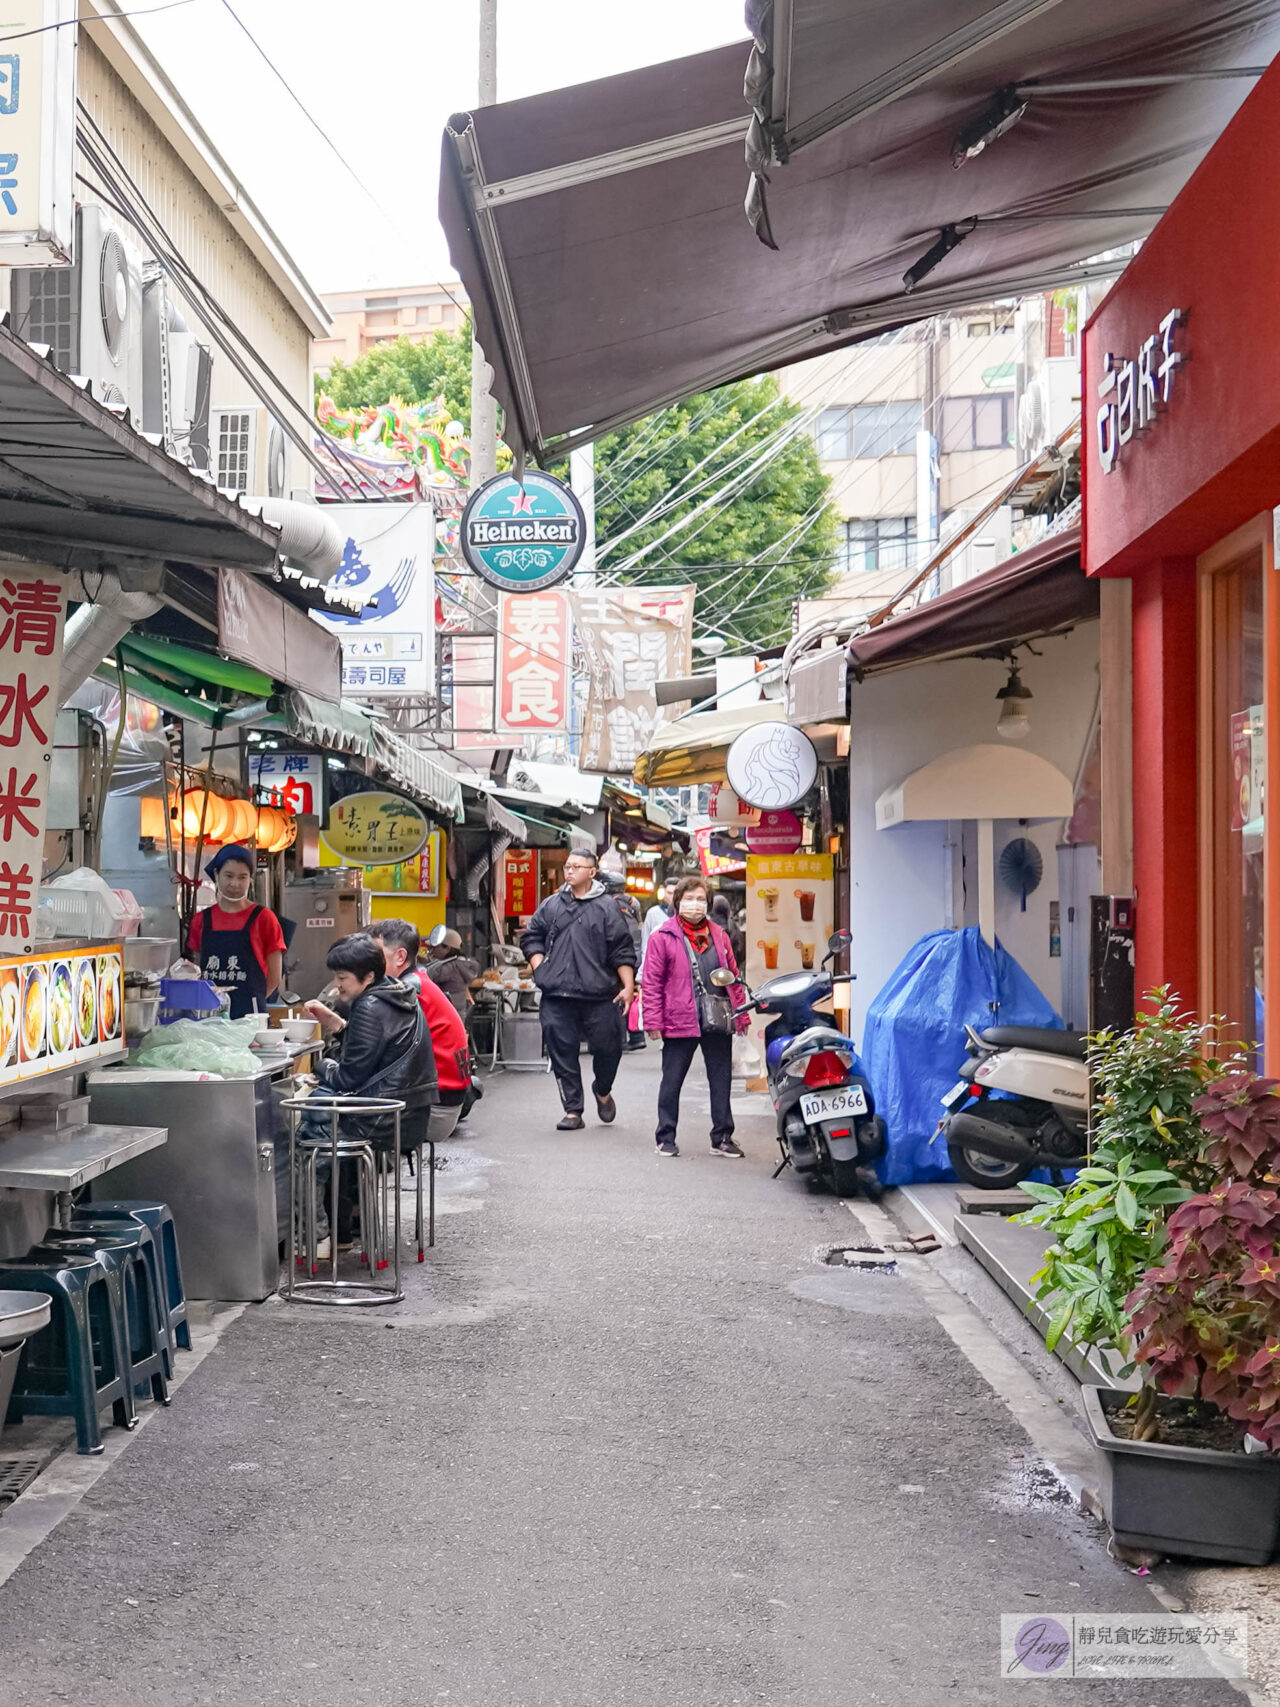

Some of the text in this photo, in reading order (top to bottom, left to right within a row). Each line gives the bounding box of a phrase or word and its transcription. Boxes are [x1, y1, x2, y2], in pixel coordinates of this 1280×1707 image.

[474, 521, 572, 543] Heineken
[506, 596, 562, 723] 素食
[507, 862, 530, 874] 日式
[206, 955, 241, 971] 廟東
